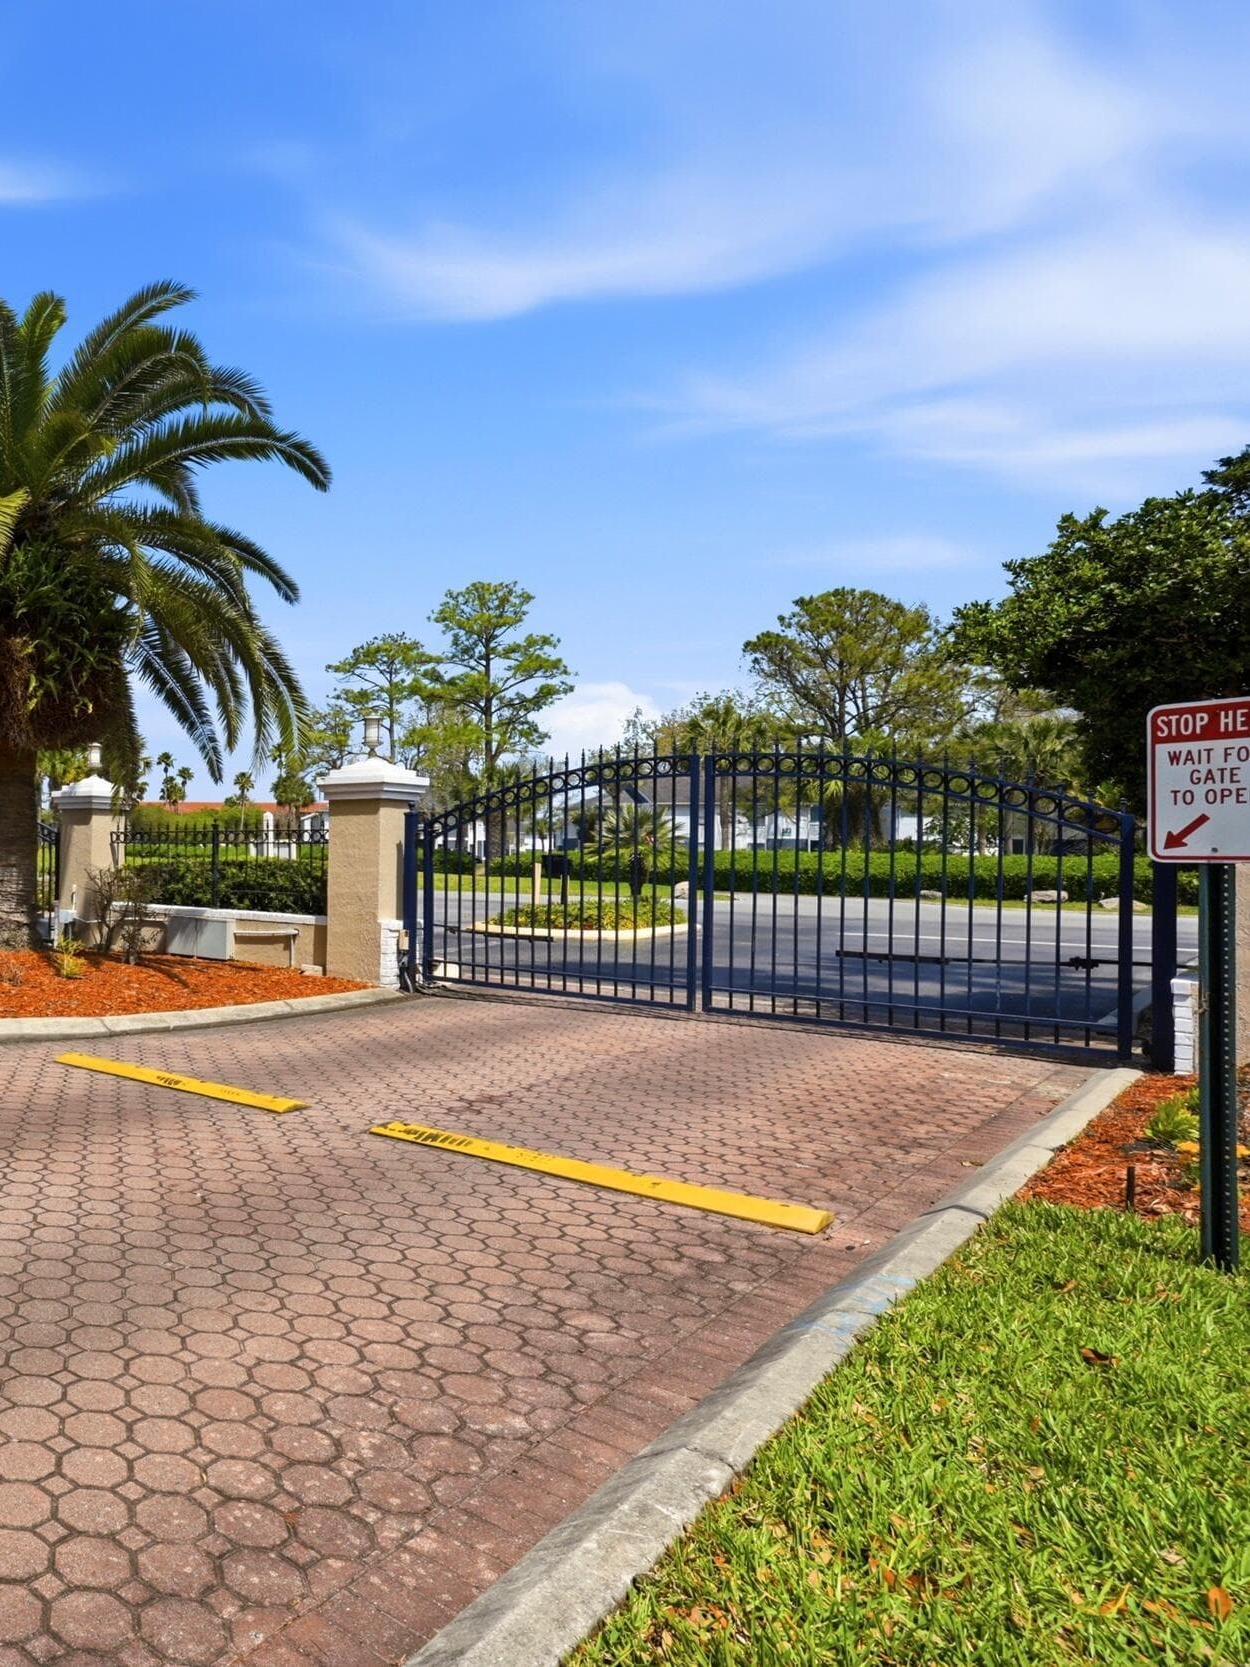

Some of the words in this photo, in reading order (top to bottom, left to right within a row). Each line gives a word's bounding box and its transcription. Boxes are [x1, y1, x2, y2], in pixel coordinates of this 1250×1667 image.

[1156, 713, 1209, 737] STOP
[1220, 709, 1249, 732] HE
[1167, 748, 1214, 766] WAIT
[1224, 746, 1250, 763] FO
[1190, 767, 1241, 785] GATE
[1170, 789, 1195, 805] TO
